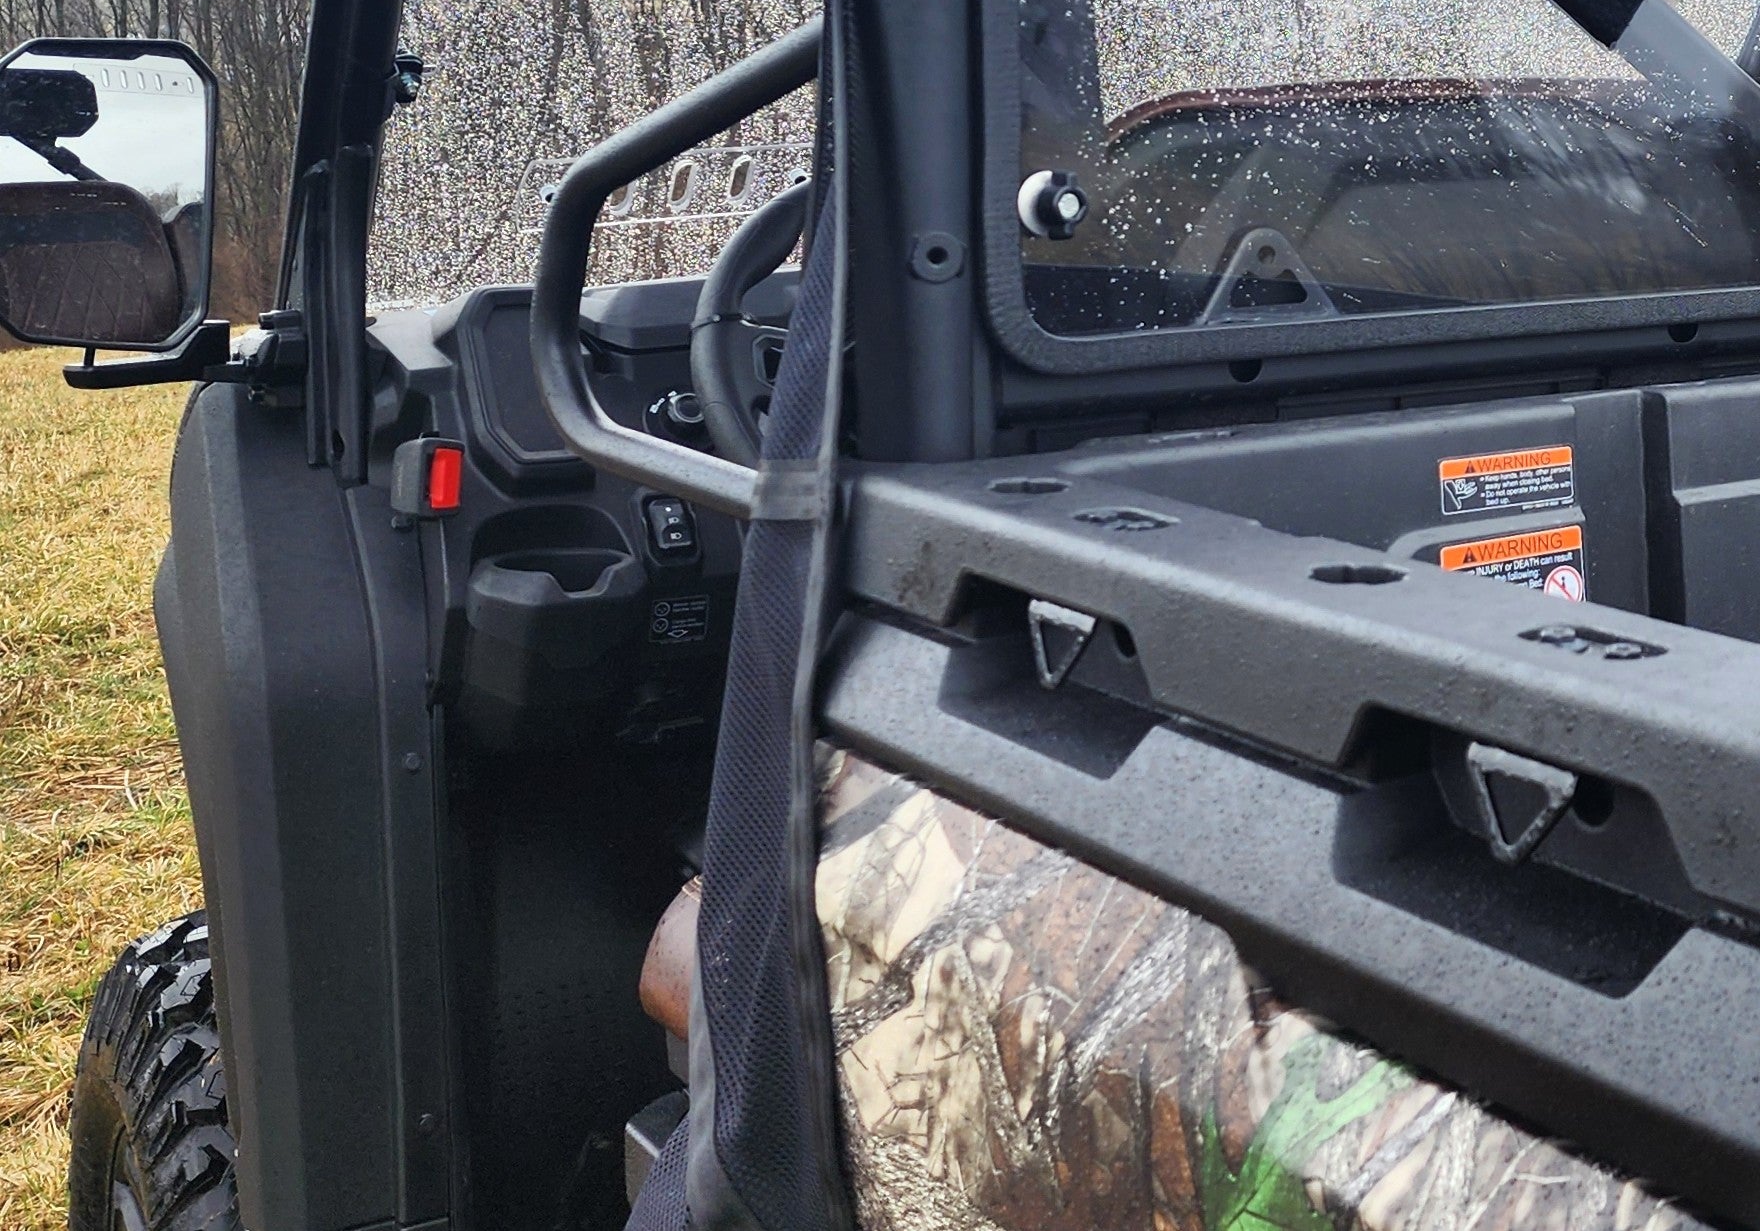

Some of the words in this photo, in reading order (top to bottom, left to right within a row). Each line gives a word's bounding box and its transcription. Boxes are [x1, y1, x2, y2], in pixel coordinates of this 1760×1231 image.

[1477, 452, 1552, 472] WARNING
[1506, 487, 1528, 496] operate
[1539, 482, 1559, 491] vehicle
[1519, 477, 1541, 485] closing
[1477, 532, 1563, 561] WARNING
[1476, 563, 1504, 576] INJURY
[1513, 556, 1539, 570] DEATH
[1540, 556, 1553, 566] can
[1554, 552, 1573, 563] result
